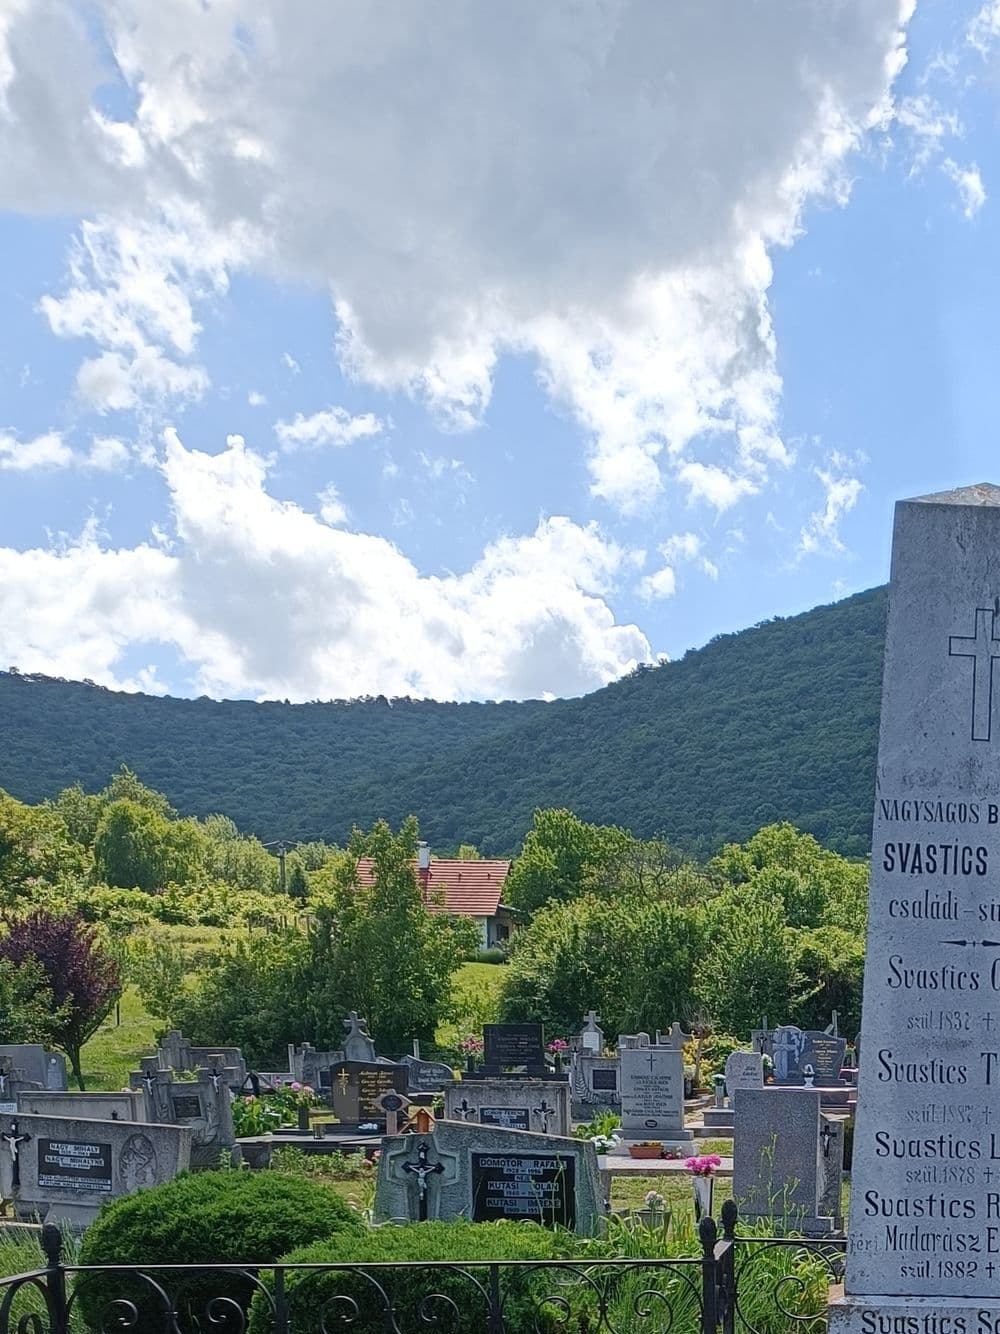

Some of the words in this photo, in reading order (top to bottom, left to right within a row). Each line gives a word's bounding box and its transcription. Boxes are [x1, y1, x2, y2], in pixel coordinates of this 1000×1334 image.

[888, 955, 980, 991] Svastics
[878, 1049, 968, 1085] Svastics
[875, 1131, 981, 1159] Svastics
[865, 1190, 976, 1218] Svastics
[886, 1225, 981, 1252] Madarász
